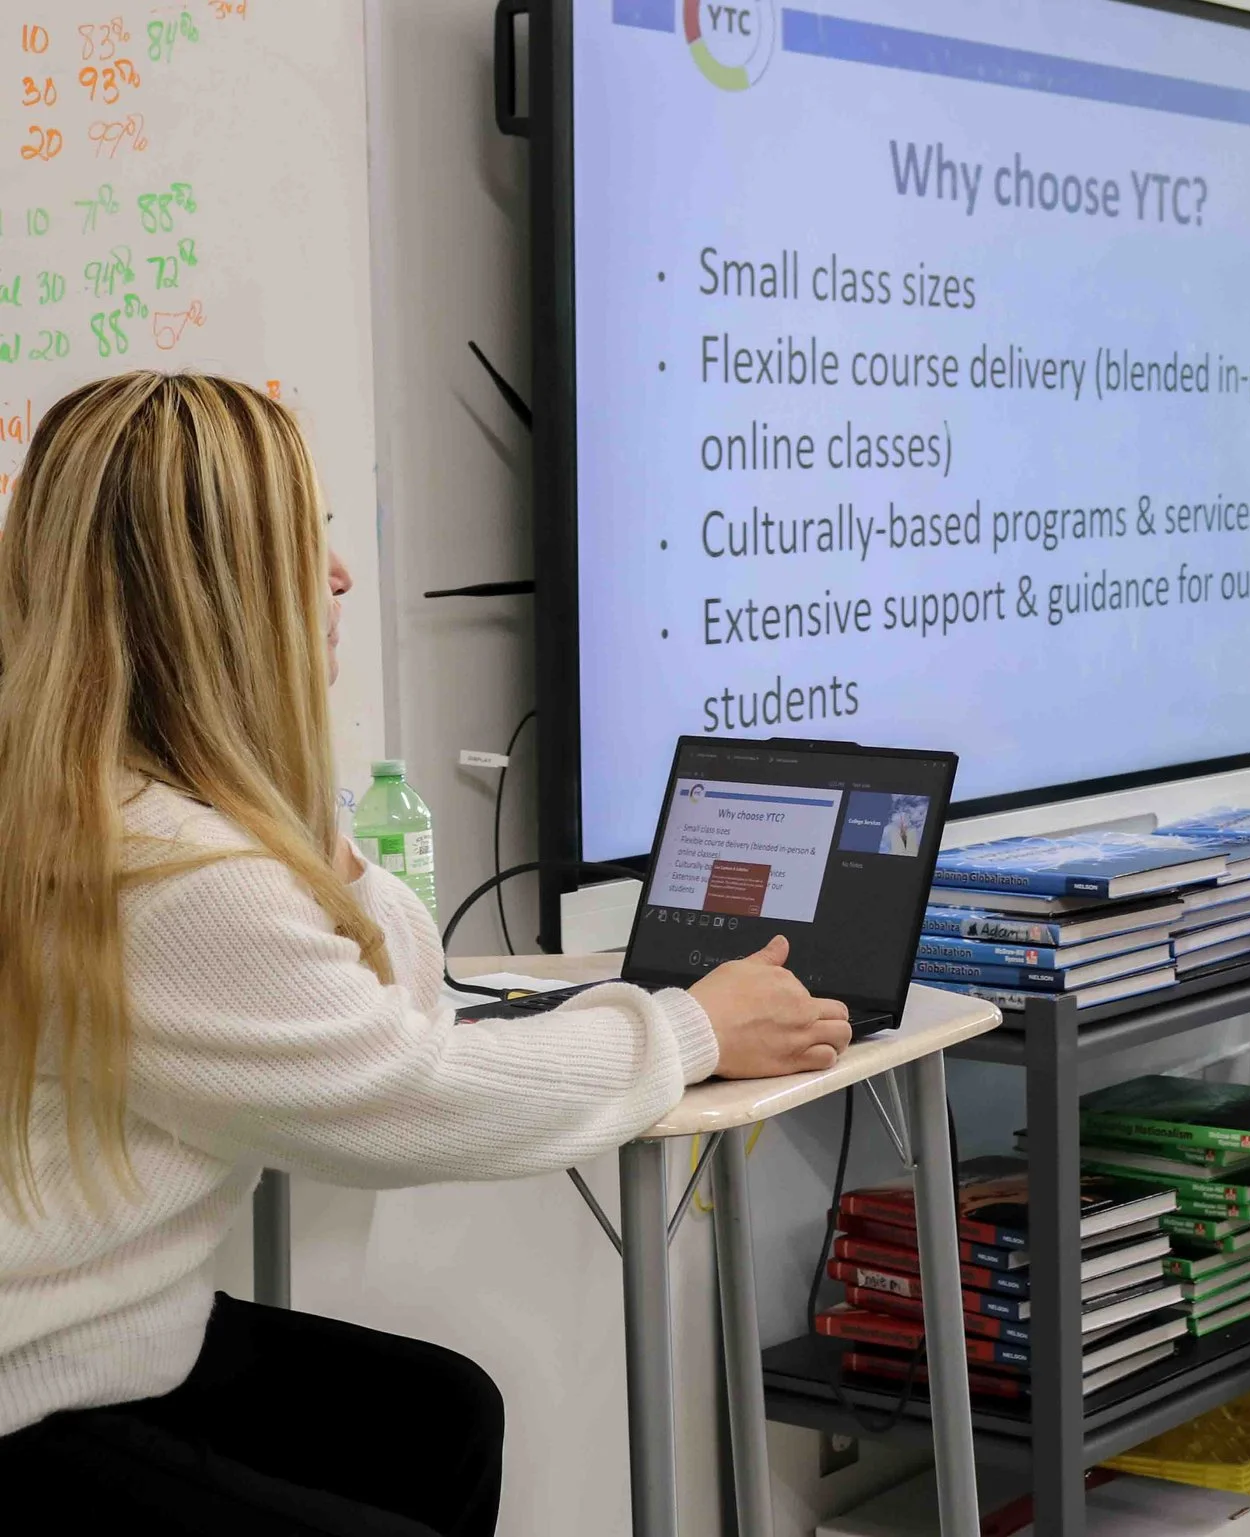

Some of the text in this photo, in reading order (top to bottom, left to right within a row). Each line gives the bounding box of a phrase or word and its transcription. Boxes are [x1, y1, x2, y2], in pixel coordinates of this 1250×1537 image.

[707, 3, 751, 37] YTC
[889, 139, 1208, 227] Why choose YTC?
[699, 246, 976, 310] Small class sizes
[702, 333, 839, 386] Flexible
[851, 351, 959, 388] course
[970, 343, 1086, 400] delivery
[1095, 347, 1209, 400] (blended
[701, 419, 952, 478] online classes)
[701, 499, 981, 562] Culturally-based
[993, 507, 1127, 553] programs
[1136, 499, 1157, 536] &
[703, 589, 872, 646] Extensive
[883, 581, 1006, 638] support
[1016, 574, 1039, 619] &
[1047, 568, 1170, 627] guidance
[1177, 562, 1214, 603] for
[702, 674, 859, 733] students
[718, 808, 785, 823] Why choose YTC?
[683, 823, 731, 836] Small class sizes
[681, 835, 703, 847] Flexible
[704, 838, 725, 848] course
[725, 839, 749, 851] delivery
[969, 872, 1029, 886] Globalization
[1073, 883, 1099, 891] NELSON
[919, 943, 972, 958] lobalization
[917, 962, 980, 977] Globalization
[1028, 974, 1054, 982] NELSON
[1002, 1235, 1025, 1245] NELSON
[1002, 1351, 1027, 1361] NELSON
